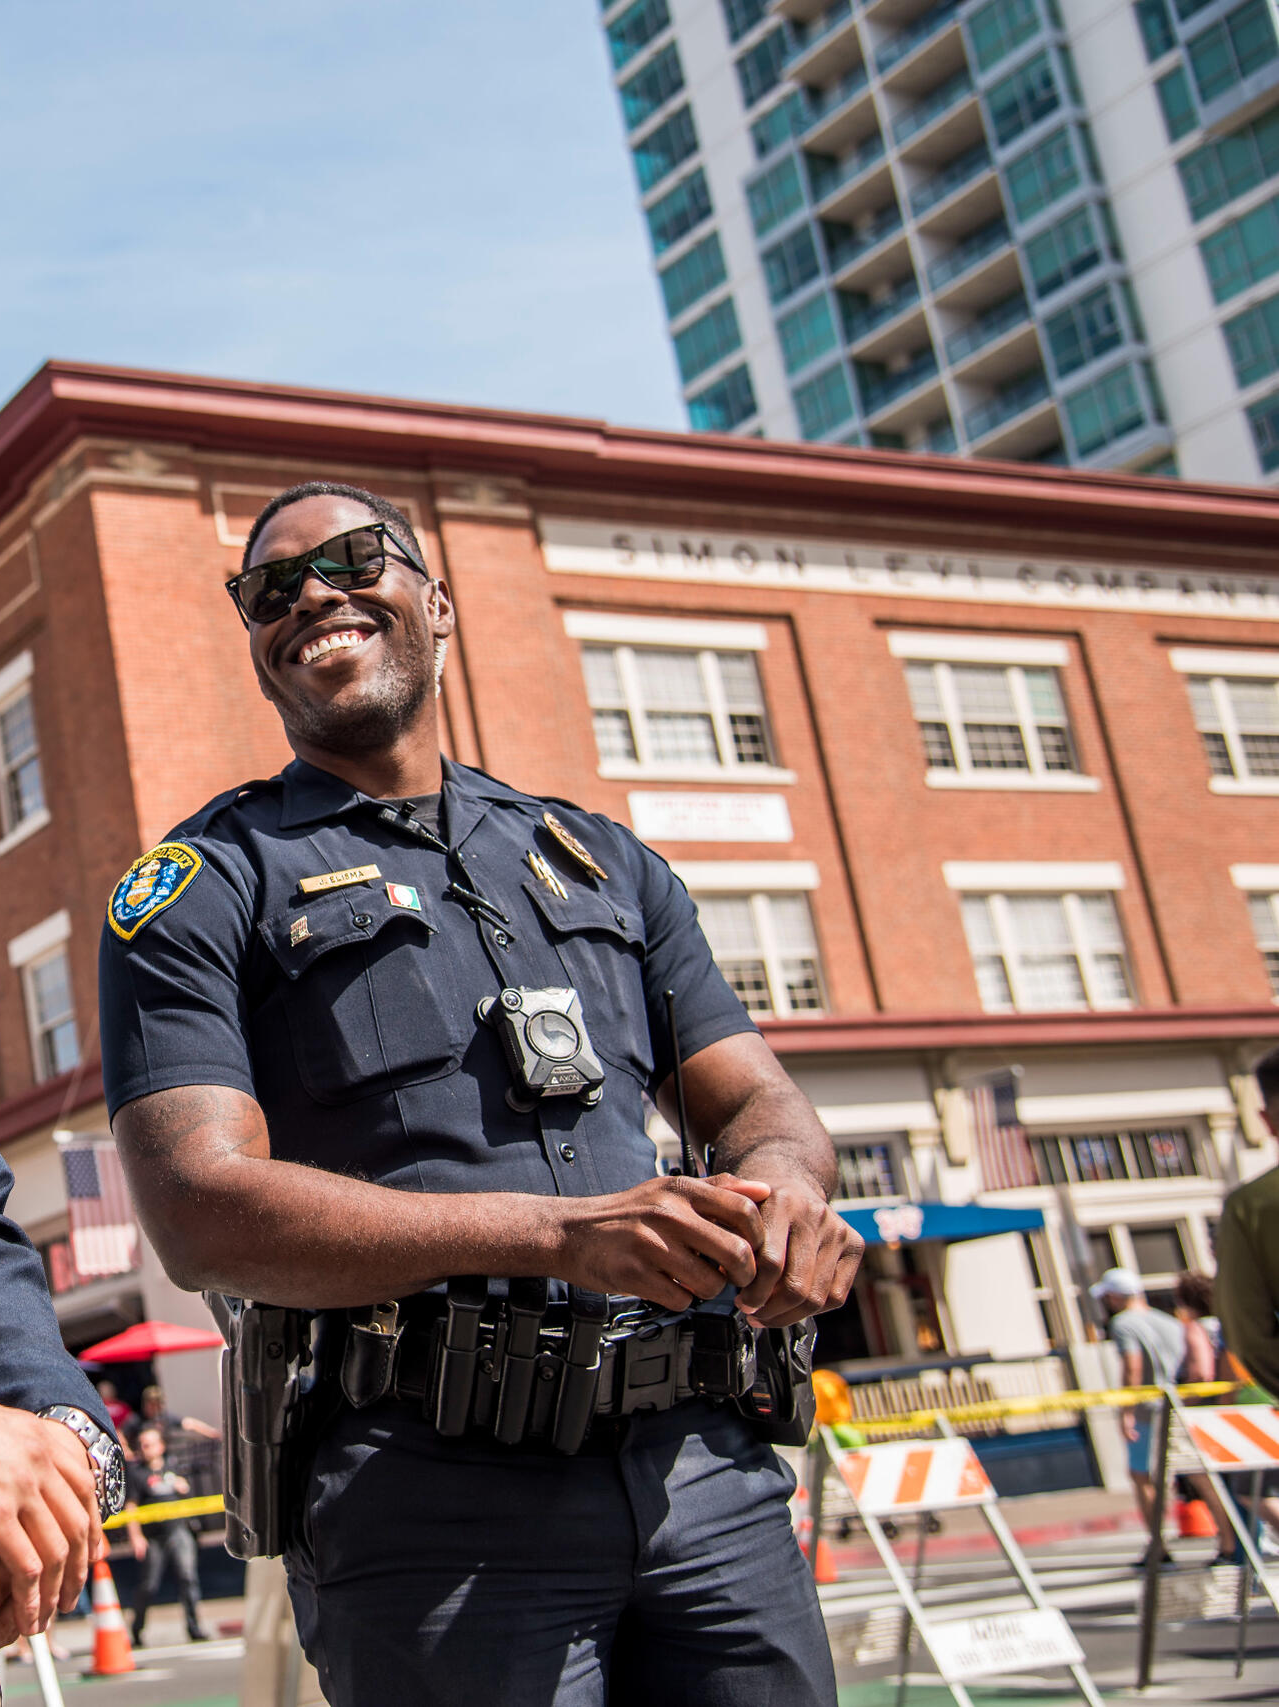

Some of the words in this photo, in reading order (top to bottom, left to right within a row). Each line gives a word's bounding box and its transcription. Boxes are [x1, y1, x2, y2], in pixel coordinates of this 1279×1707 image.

[611, 533, 806, 577] SIMON
[843, 552, 983, 592] LEVI
[1015, 562, 1271, 611] COMPANY
[329, 870, 365, 884] ELISMA
